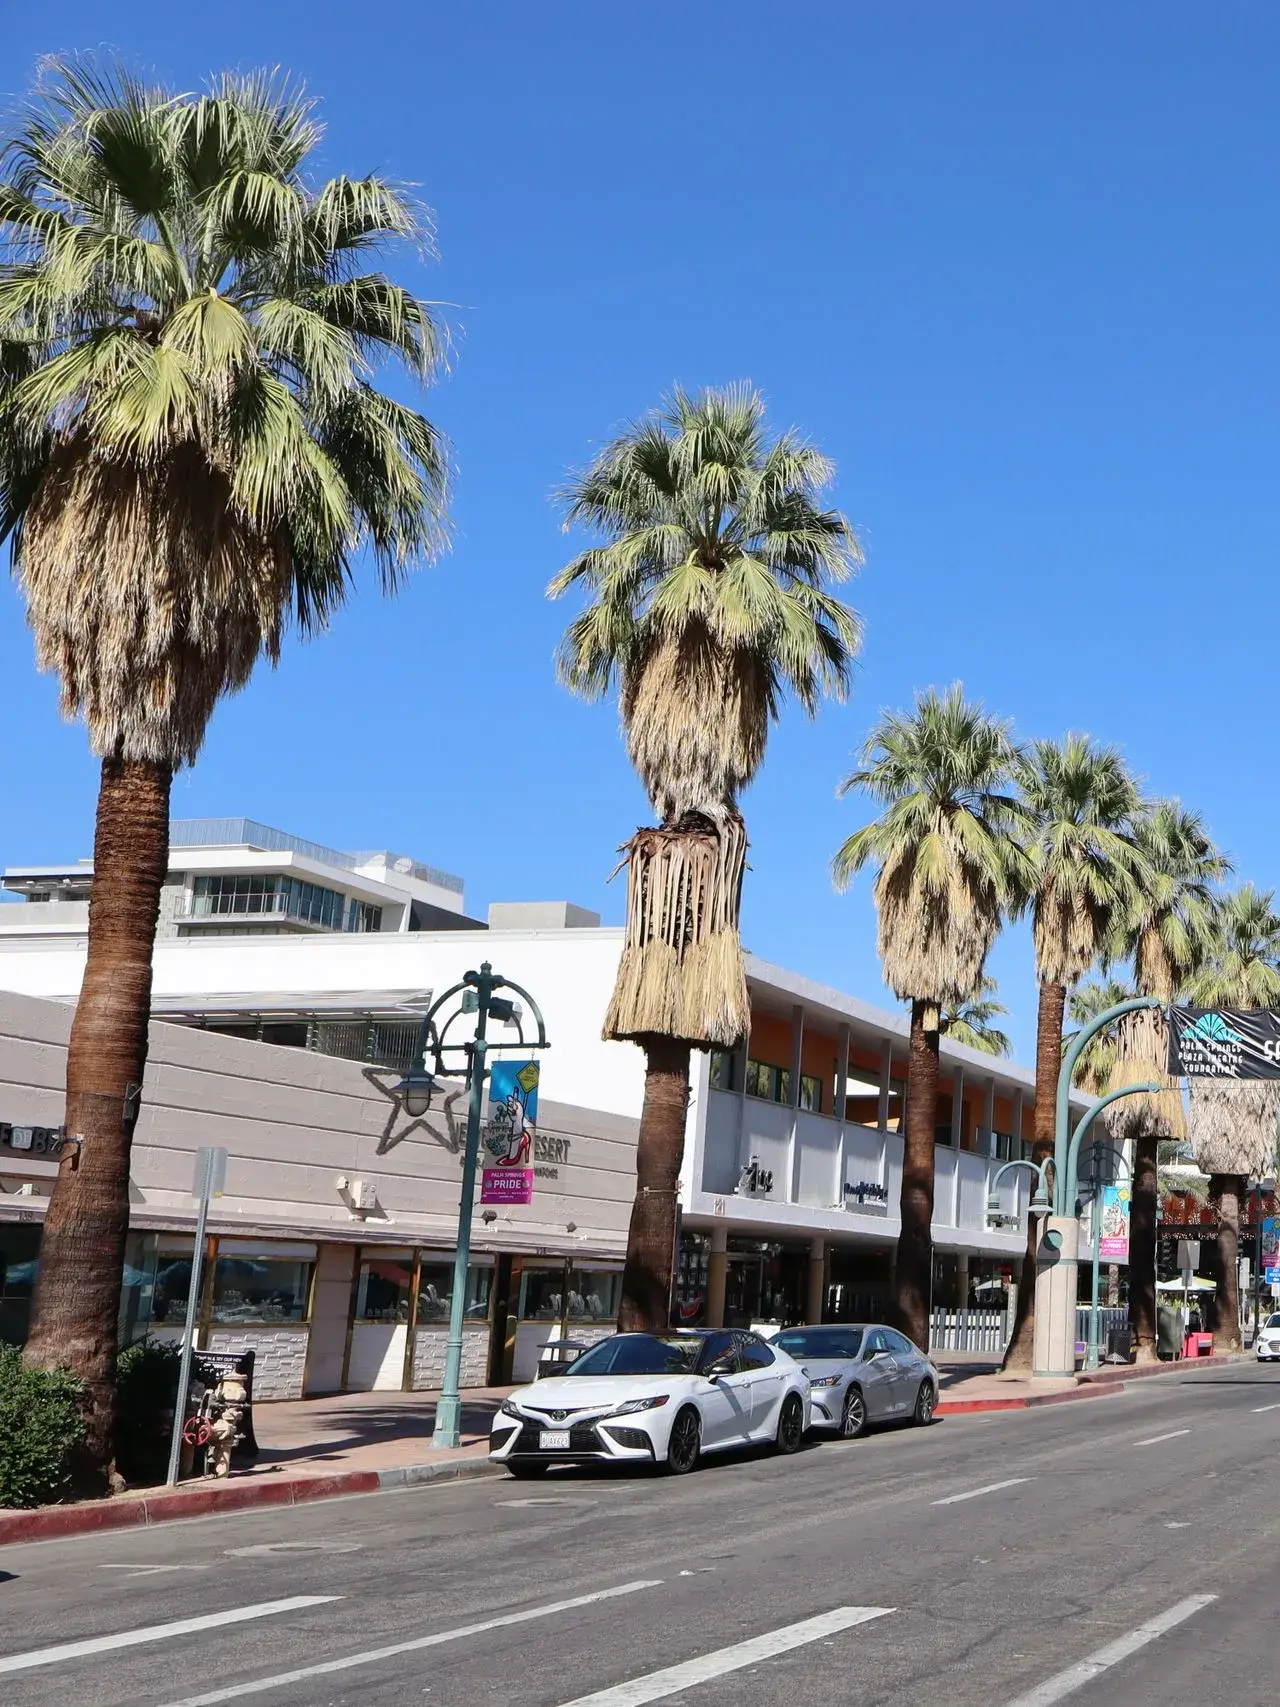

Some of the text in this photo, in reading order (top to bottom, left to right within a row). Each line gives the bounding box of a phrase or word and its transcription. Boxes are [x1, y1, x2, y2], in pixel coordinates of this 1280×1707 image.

[1180, 1041, 1242, 1053] PALM SPRINGS
[1178, 1052, 1243, 1063] PLAZA THEATRE
[1184, 1064, 1235, 1074] FOUNDATION
[534, 1134, 571, 1164] ESERT
[493, 1179, 522, 1189] PRIDE
